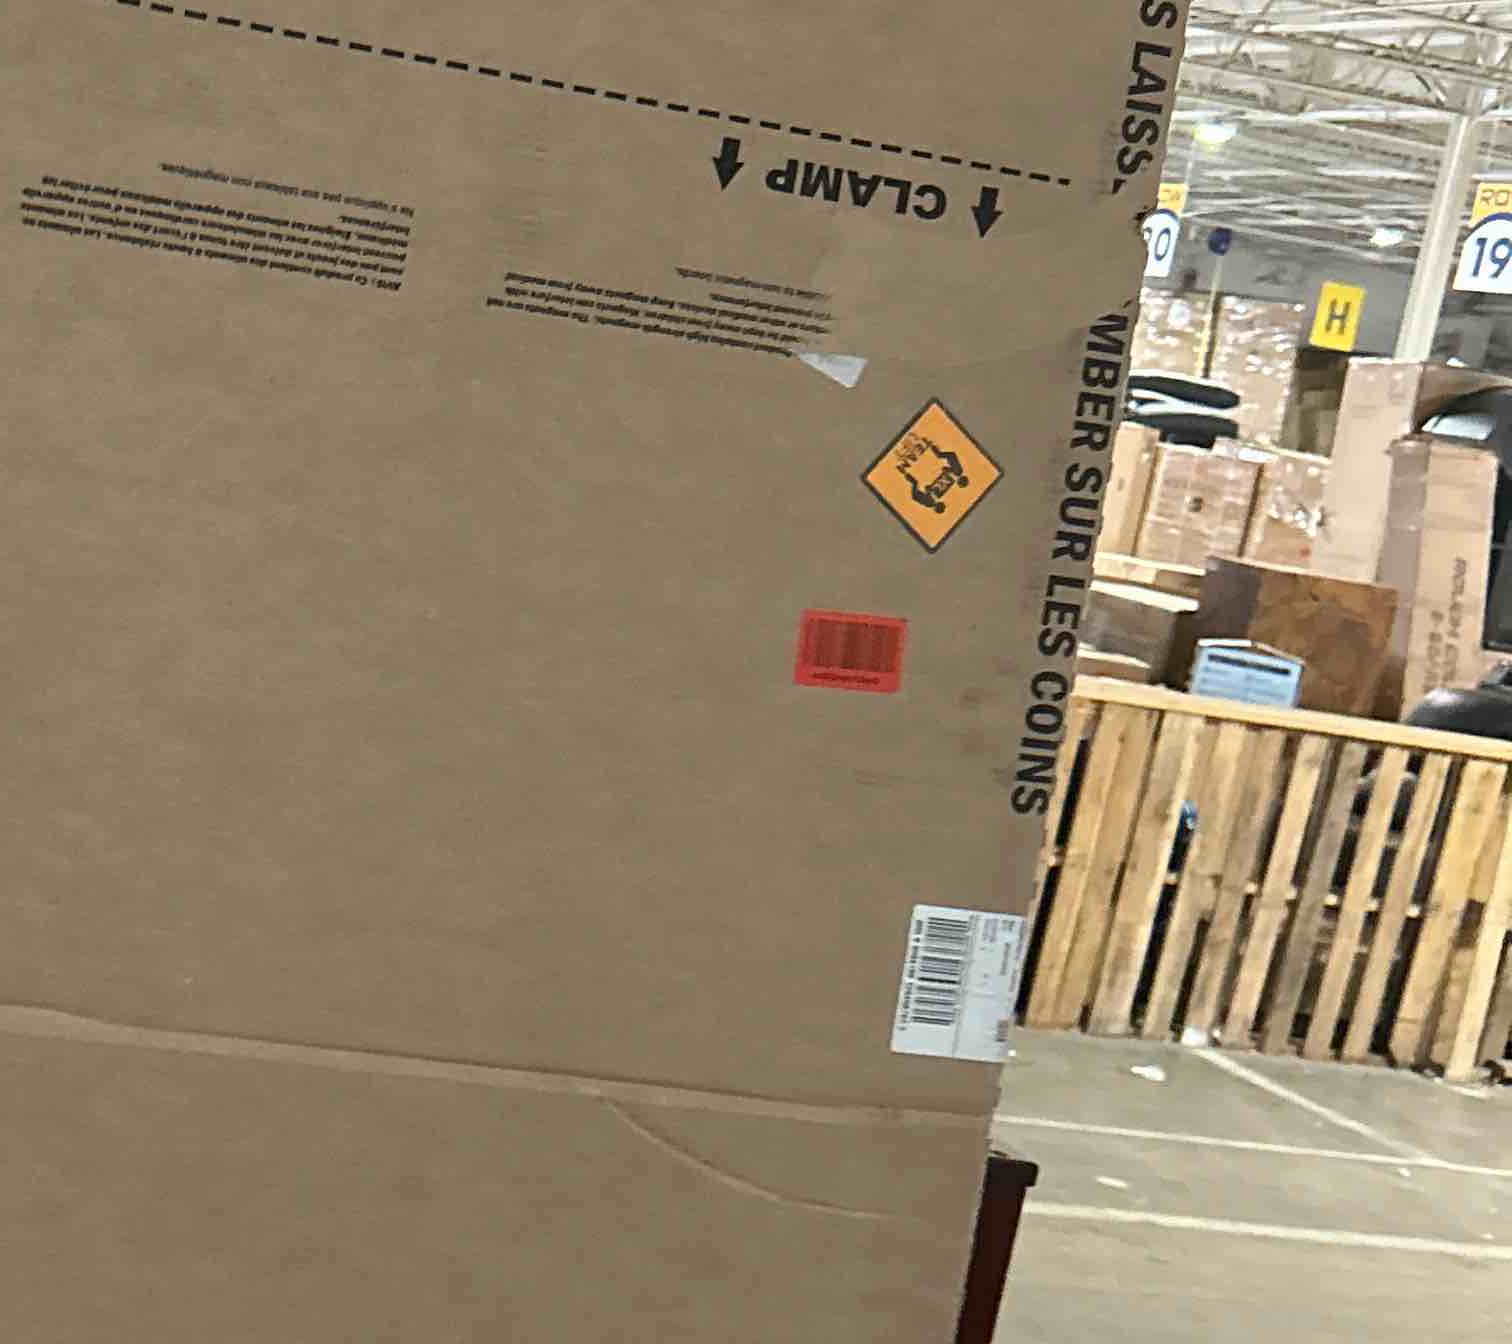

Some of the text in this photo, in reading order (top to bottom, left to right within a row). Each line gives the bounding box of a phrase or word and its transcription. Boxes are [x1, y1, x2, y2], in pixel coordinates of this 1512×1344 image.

[1112, 41, 1173, 195] LAISS
[764, 158, 947, 220] CLAMP
[1479, 188, 1512, 206] RO
[1010, 313, 1129, 816] MBER SUR LES COINS
